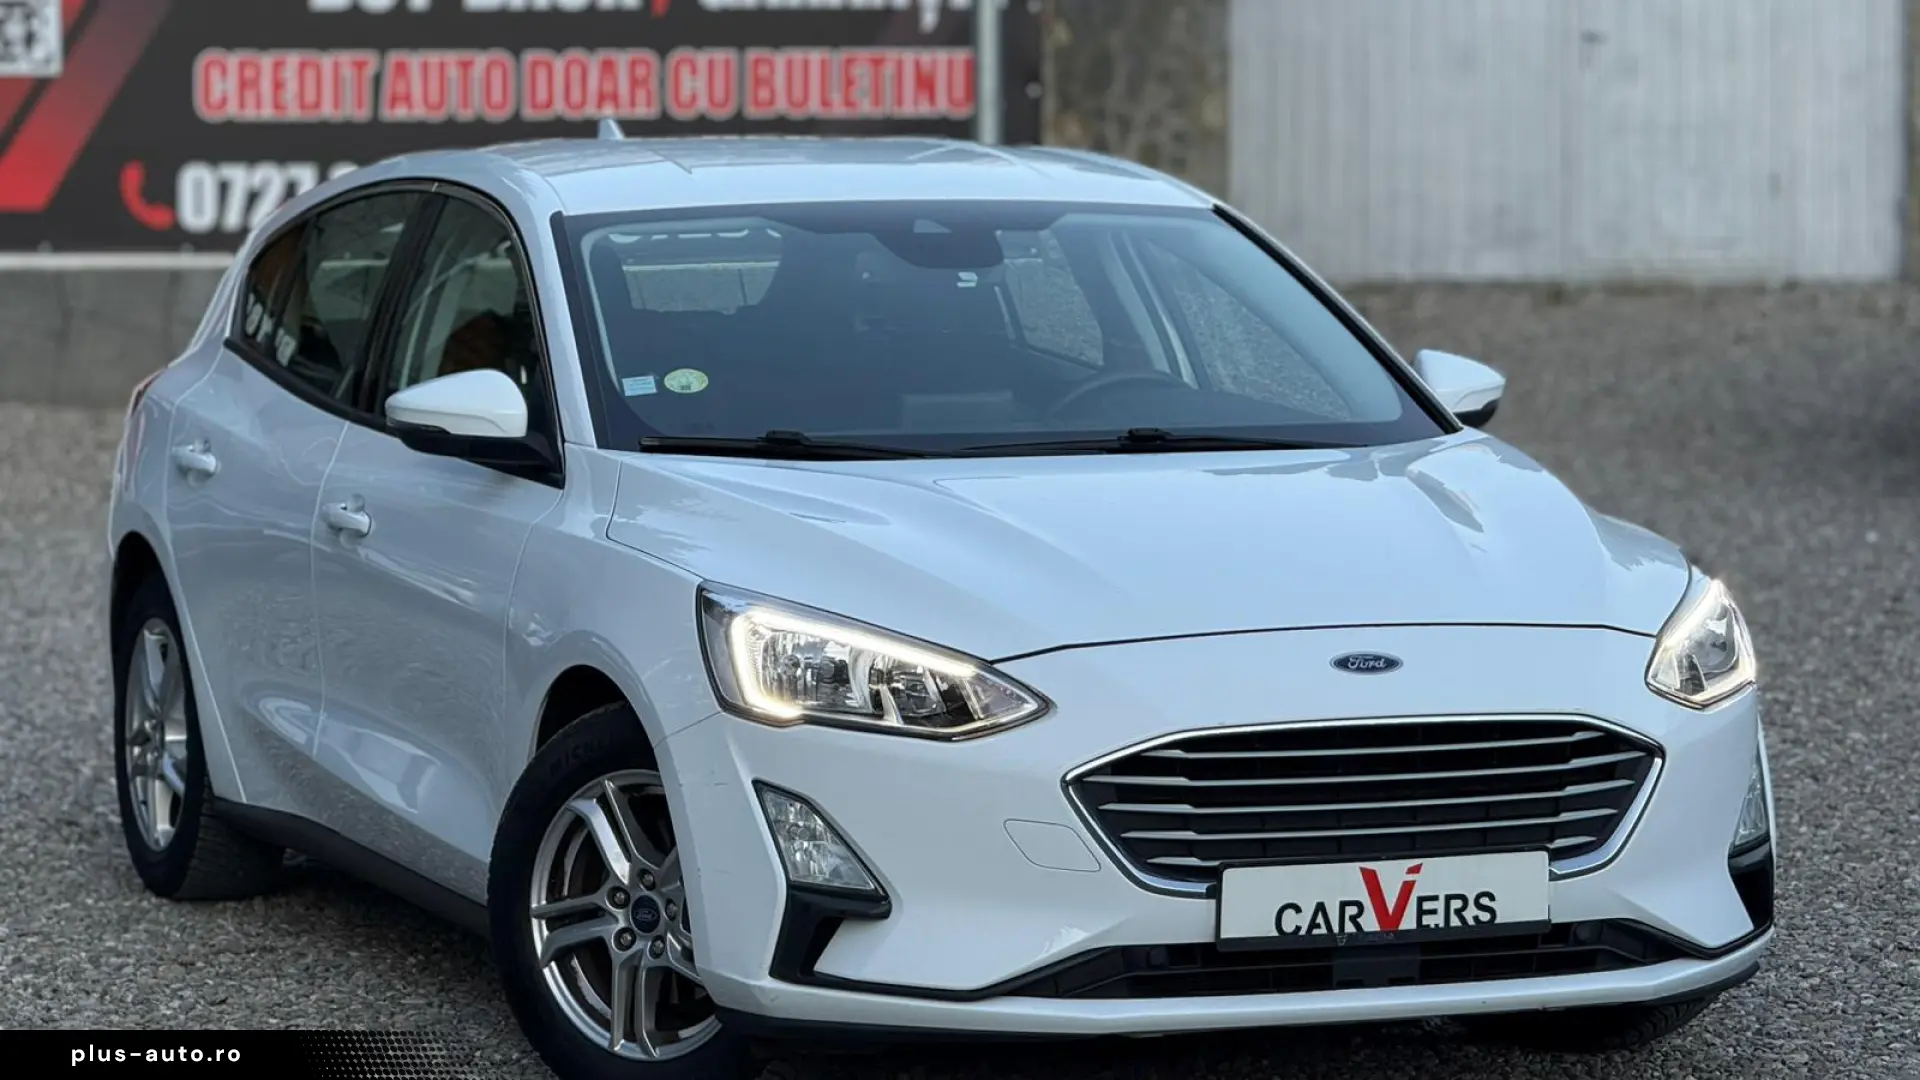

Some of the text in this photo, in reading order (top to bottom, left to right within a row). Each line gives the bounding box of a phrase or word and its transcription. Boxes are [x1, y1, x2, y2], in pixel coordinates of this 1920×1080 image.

[194, 47, 975, 122] CREDIT AUTO DOAR CU BULETINU
[1347, 655, 1388, 669] Ford
[1274, 862, 1498, 936] CARVERS
